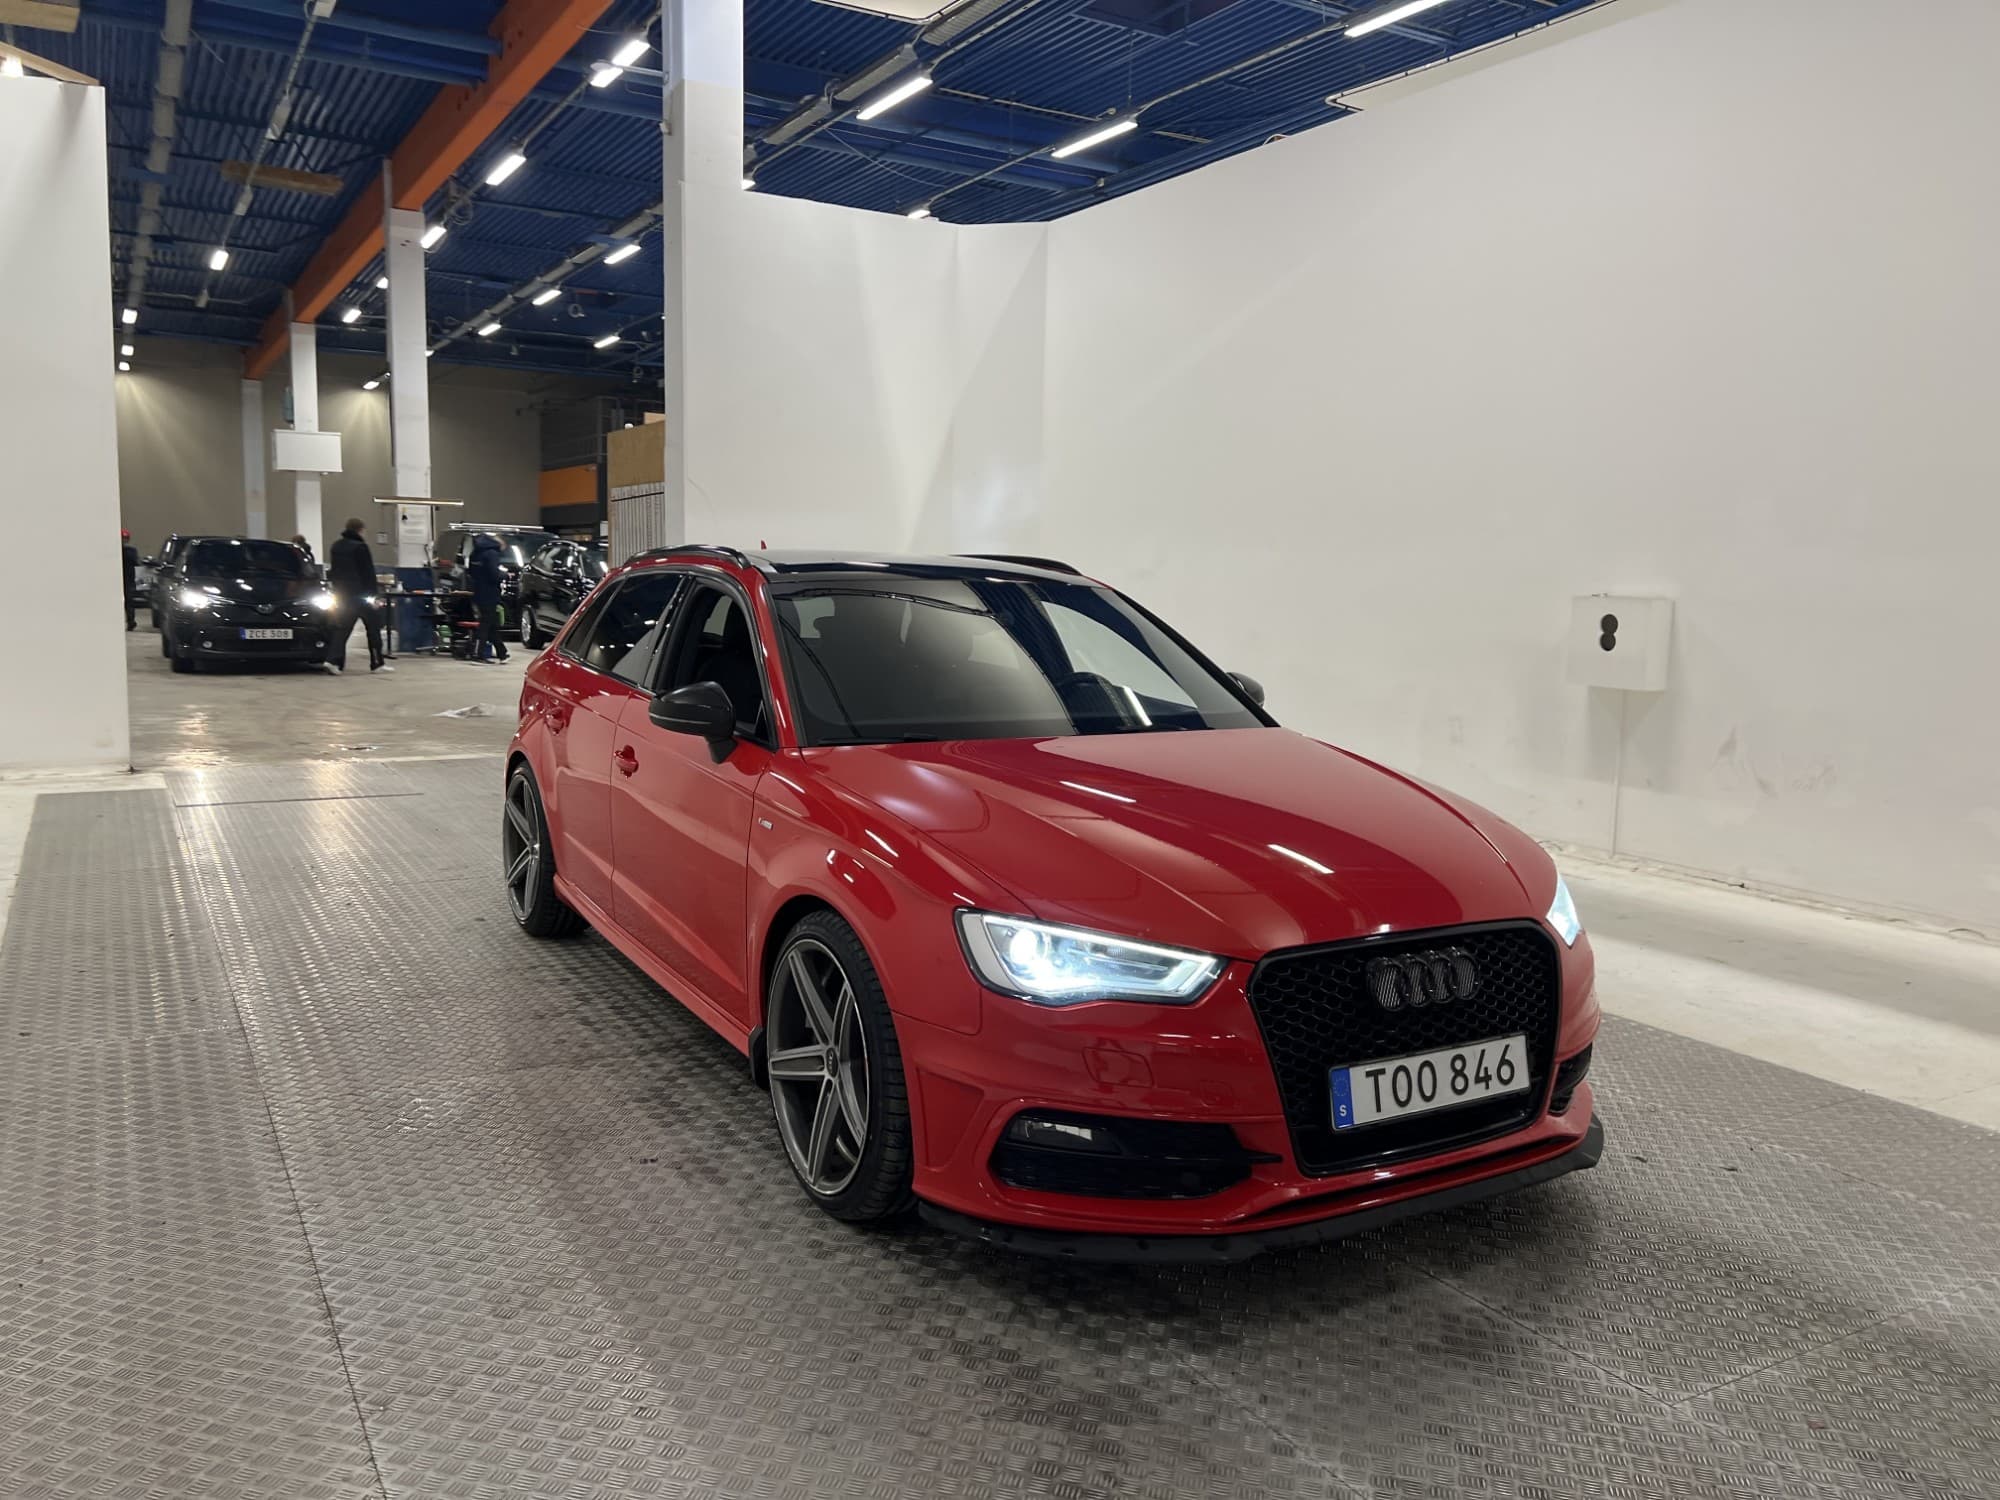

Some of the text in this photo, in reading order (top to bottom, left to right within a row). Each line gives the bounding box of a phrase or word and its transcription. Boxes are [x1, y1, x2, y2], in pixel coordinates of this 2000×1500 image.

[248, 630, 266, 638] ZCE
[1365, 1044, 1515, 1113] TOO 846
[1338, 1104, 1348, 1117] S
